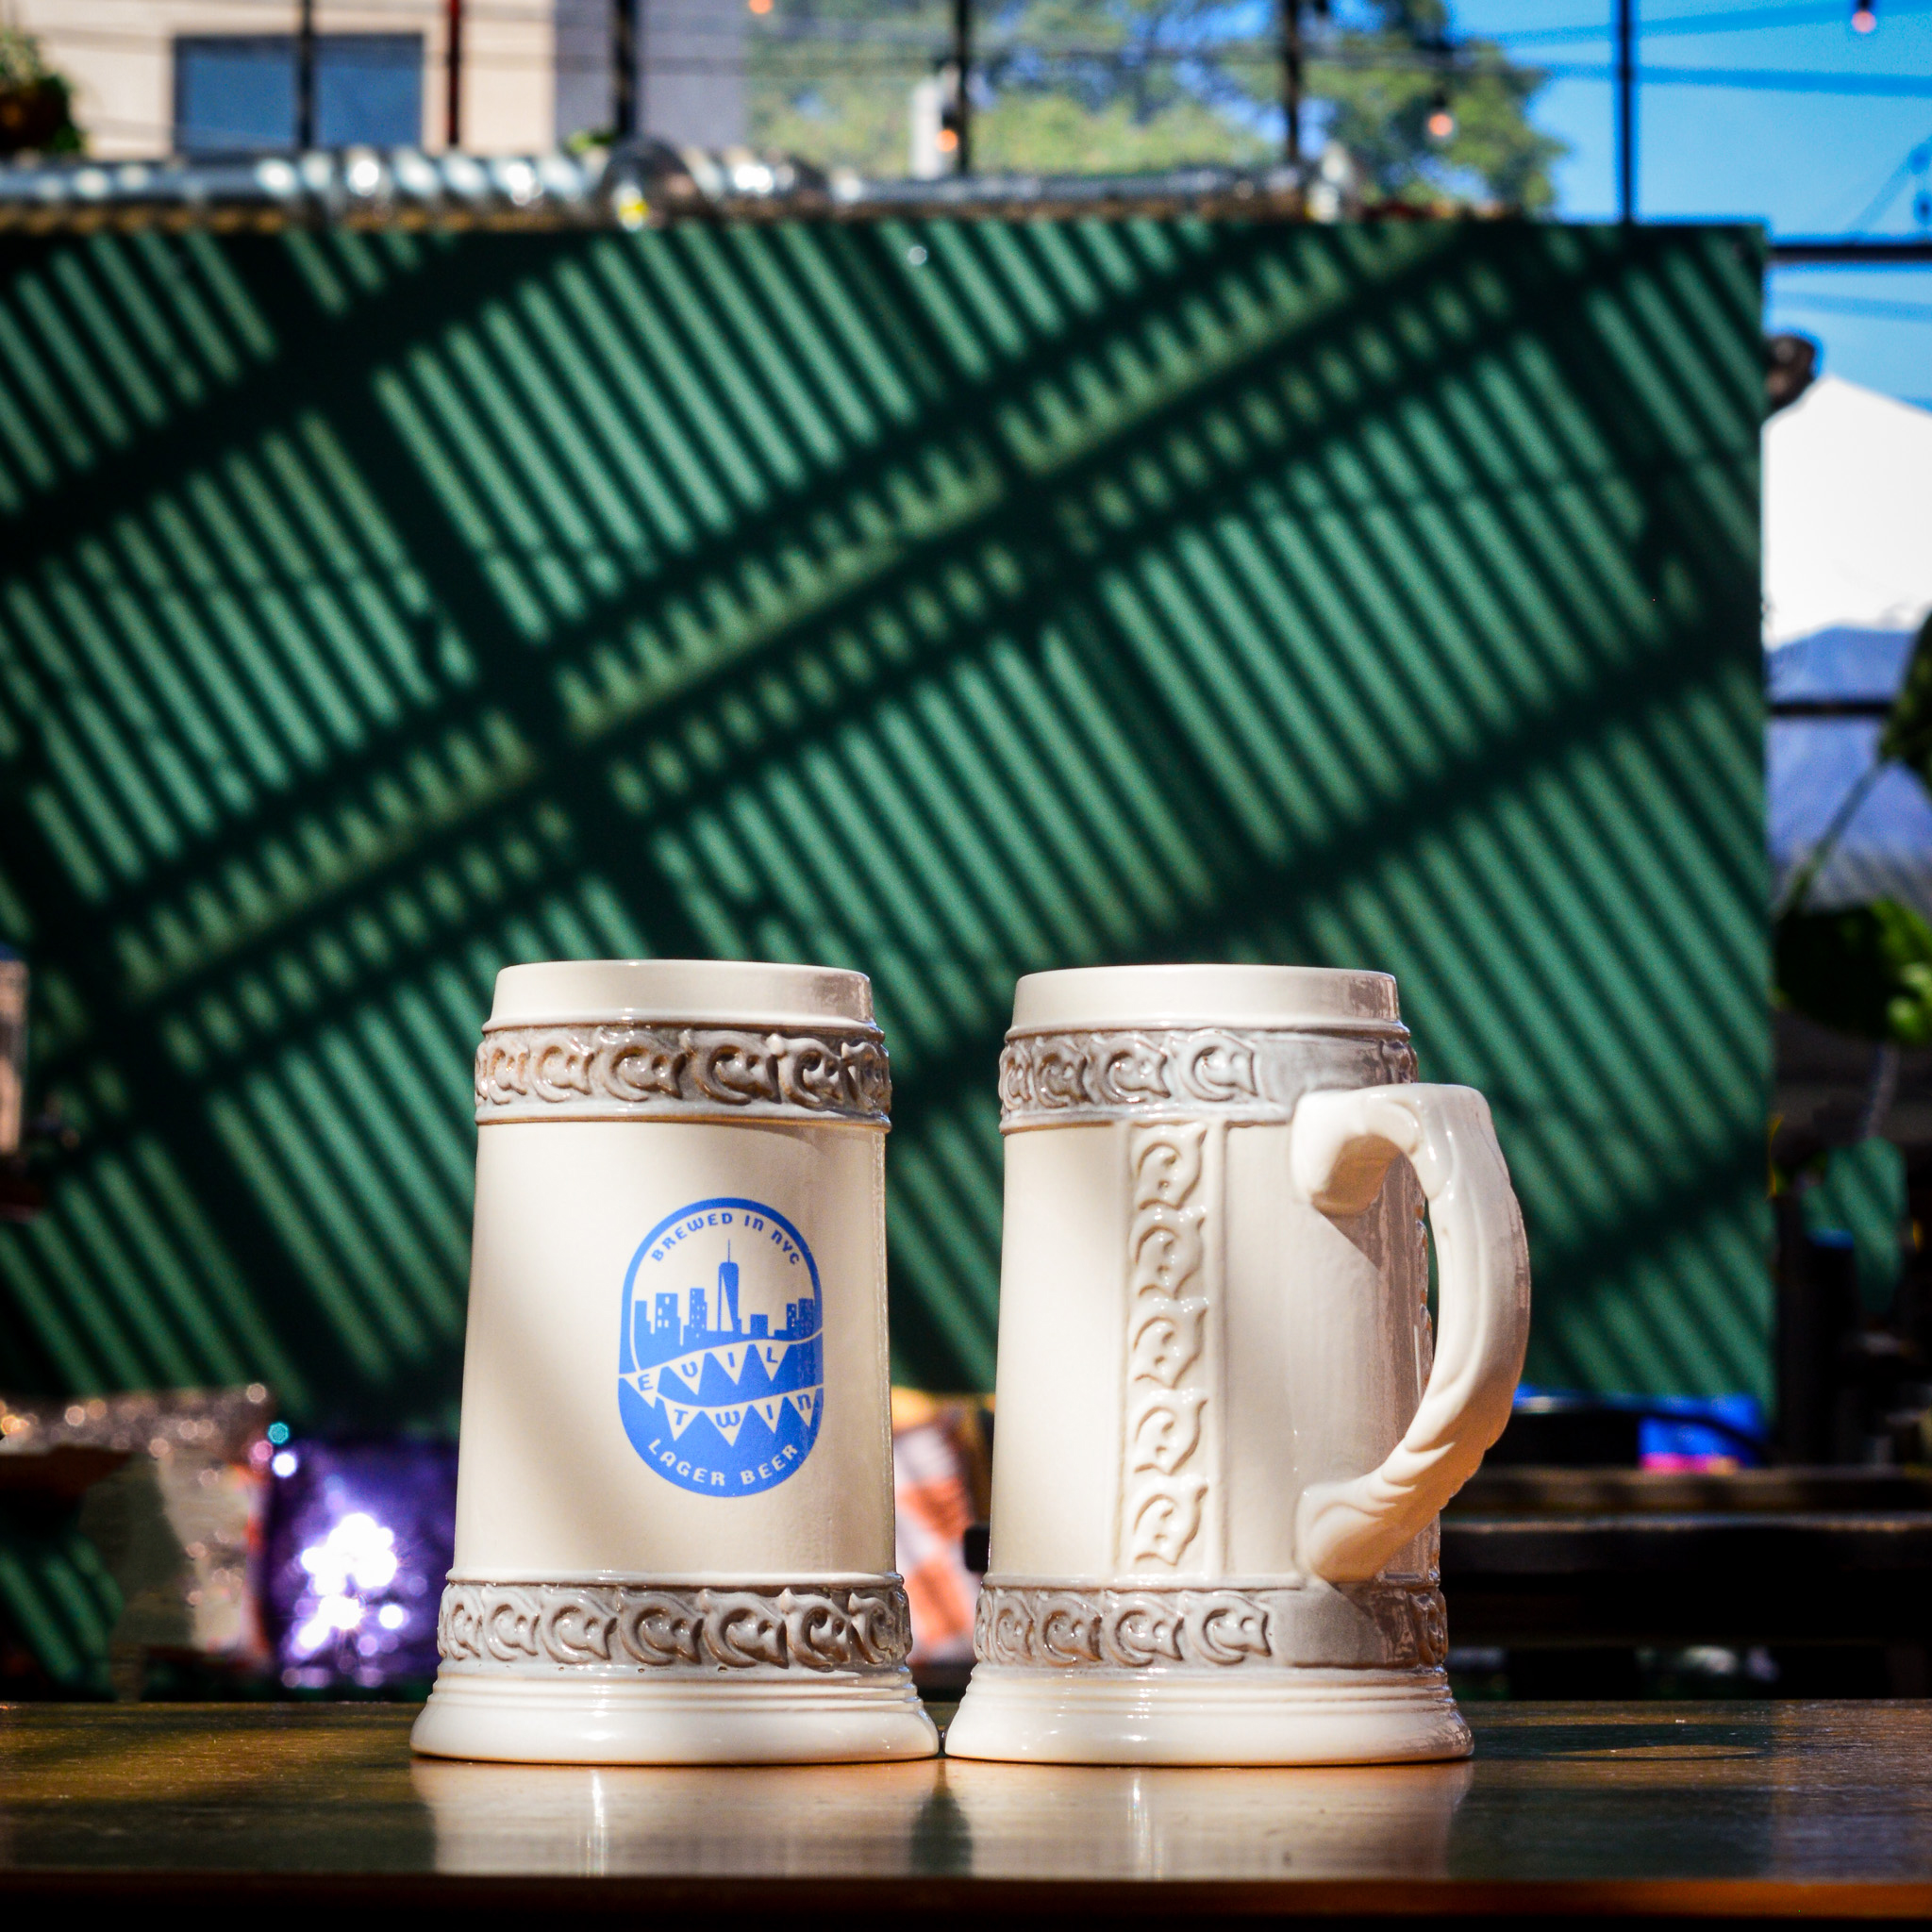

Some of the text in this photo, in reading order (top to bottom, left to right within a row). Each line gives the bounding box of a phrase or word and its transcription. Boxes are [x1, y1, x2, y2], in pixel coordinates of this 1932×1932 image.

[651, 1212, 733, 1262] BREWED
[771, 1228, 800, 1265] NYC
[648, 1438, 799, 1487] LAGER BEER
